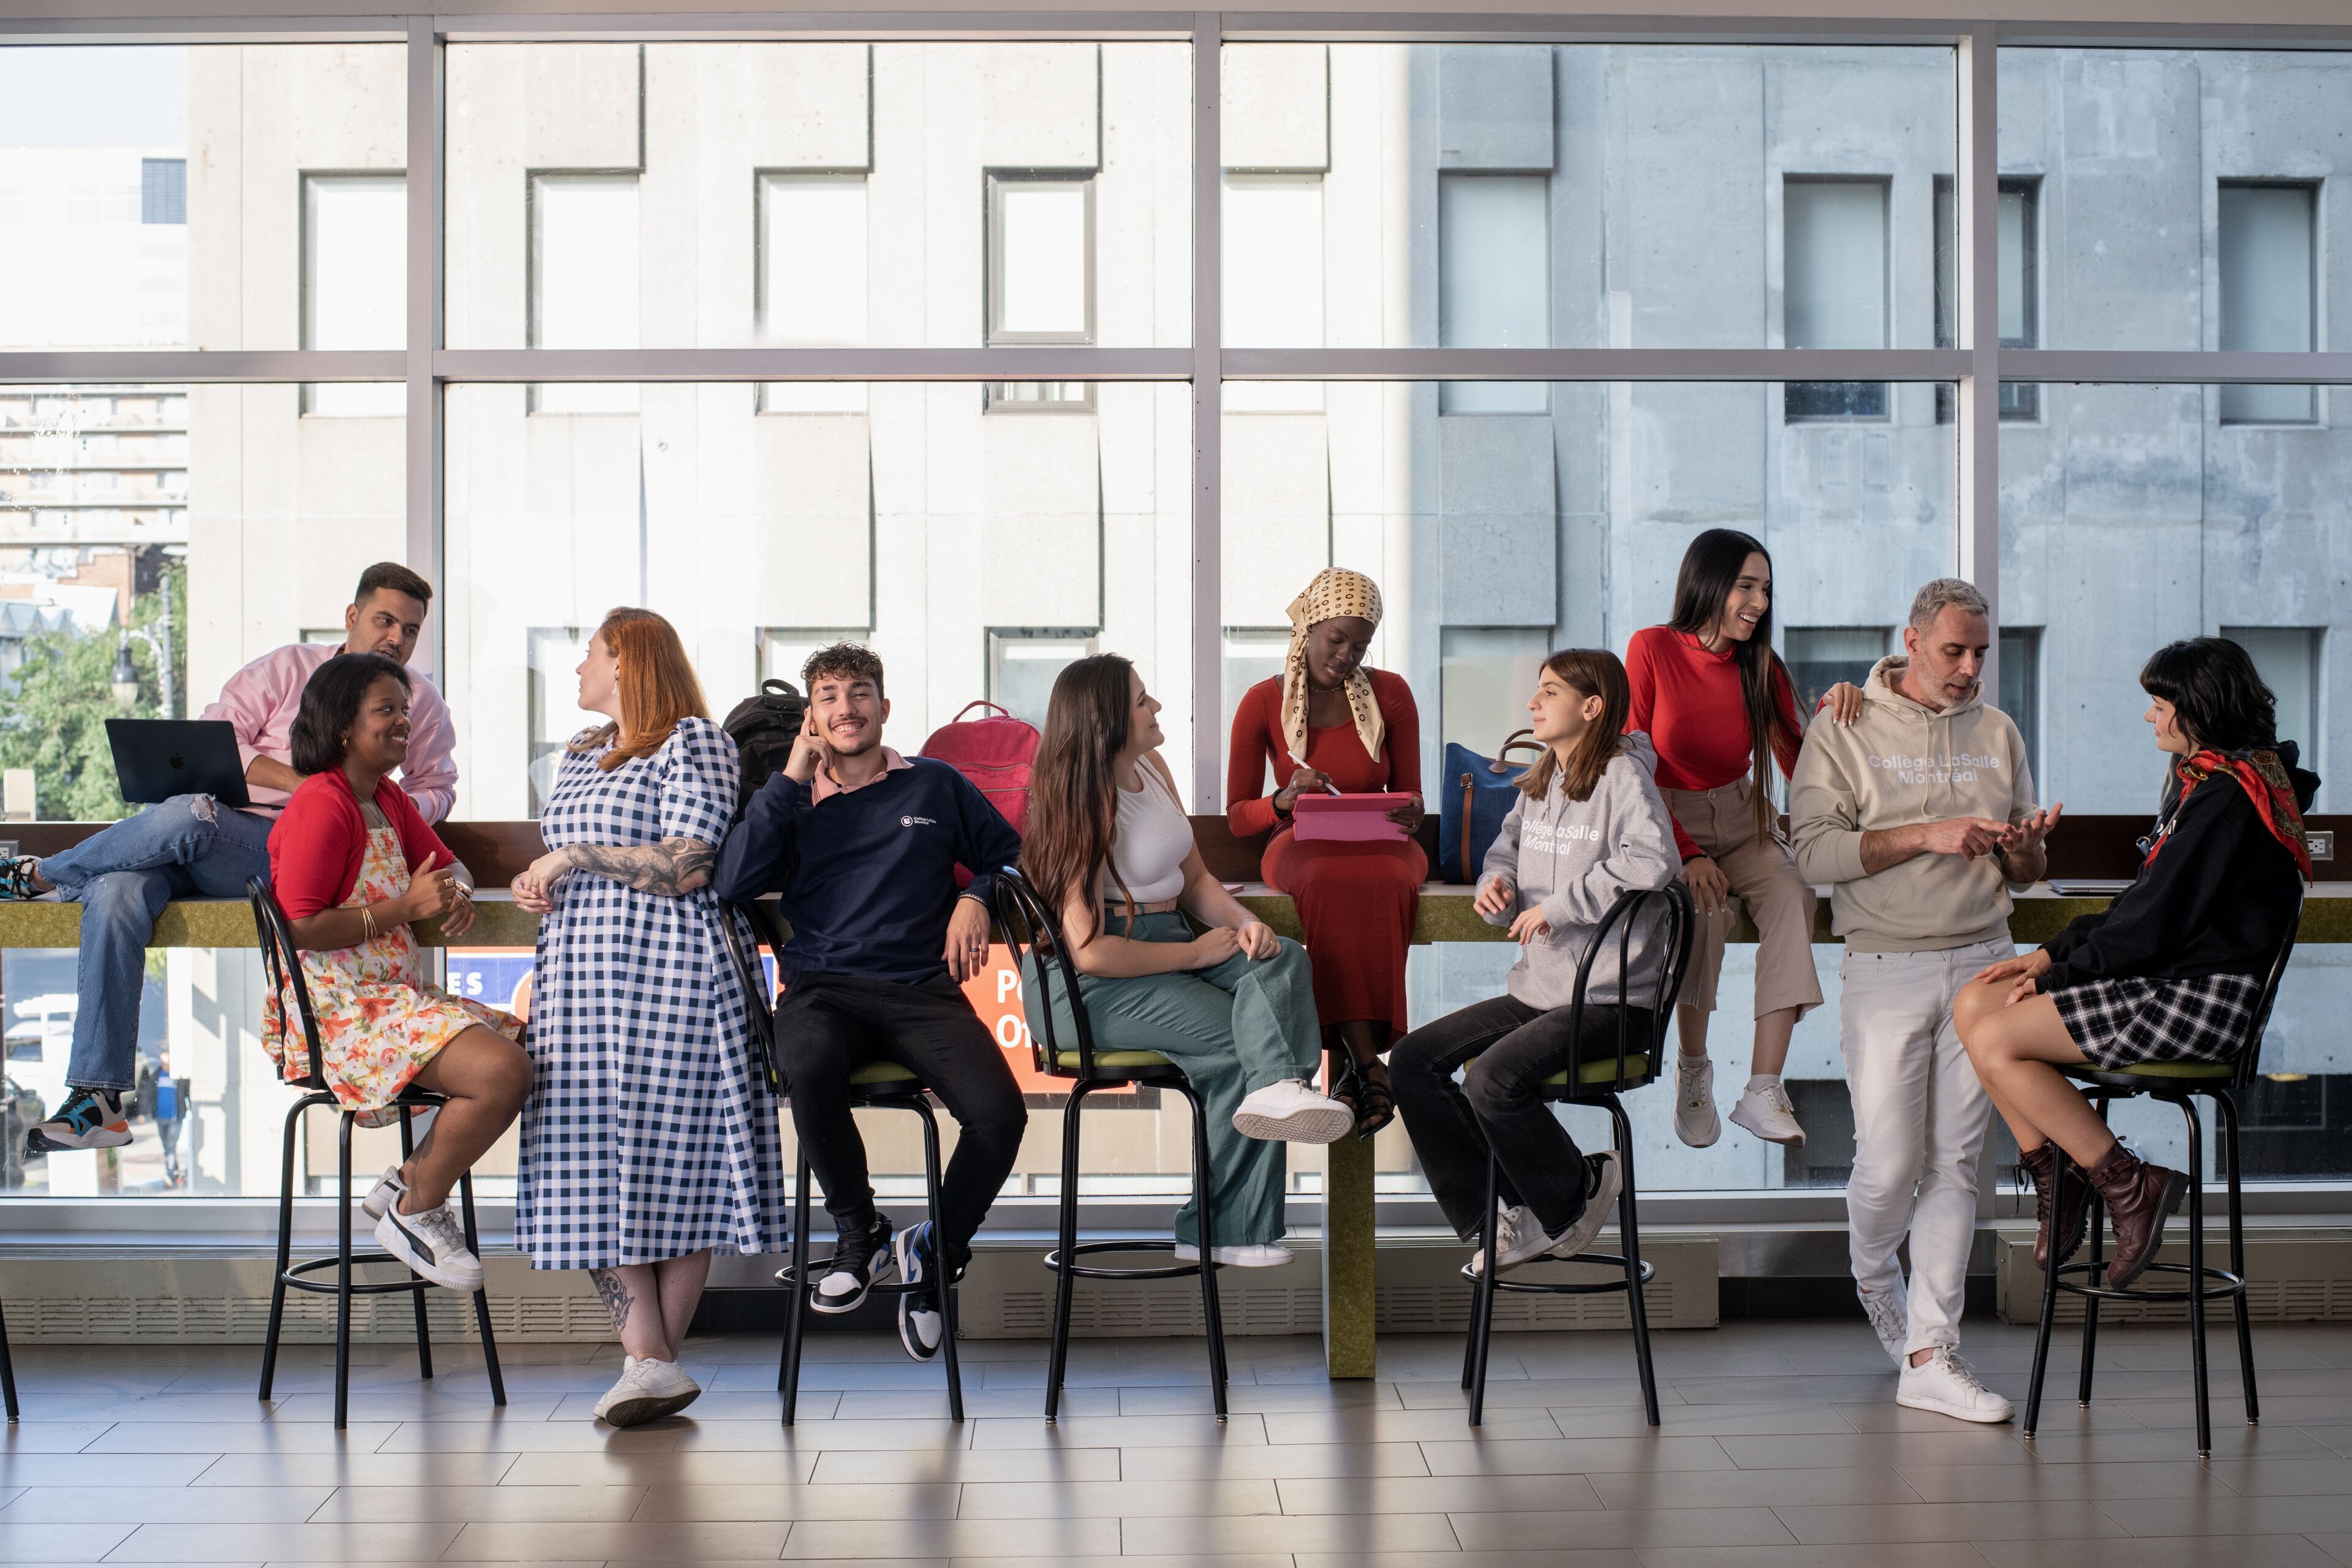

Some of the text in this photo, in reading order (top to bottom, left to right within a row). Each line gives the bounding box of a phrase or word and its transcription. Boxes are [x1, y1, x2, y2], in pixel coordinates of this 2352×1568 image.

[1868, 753, 2000, 771] Collège LaSalle
[1898, 768, 1978, 785] Montréal
[1522, 820, 1599, 841] ollège aSalle
[1523, 834, 1571, 855] Montéal
